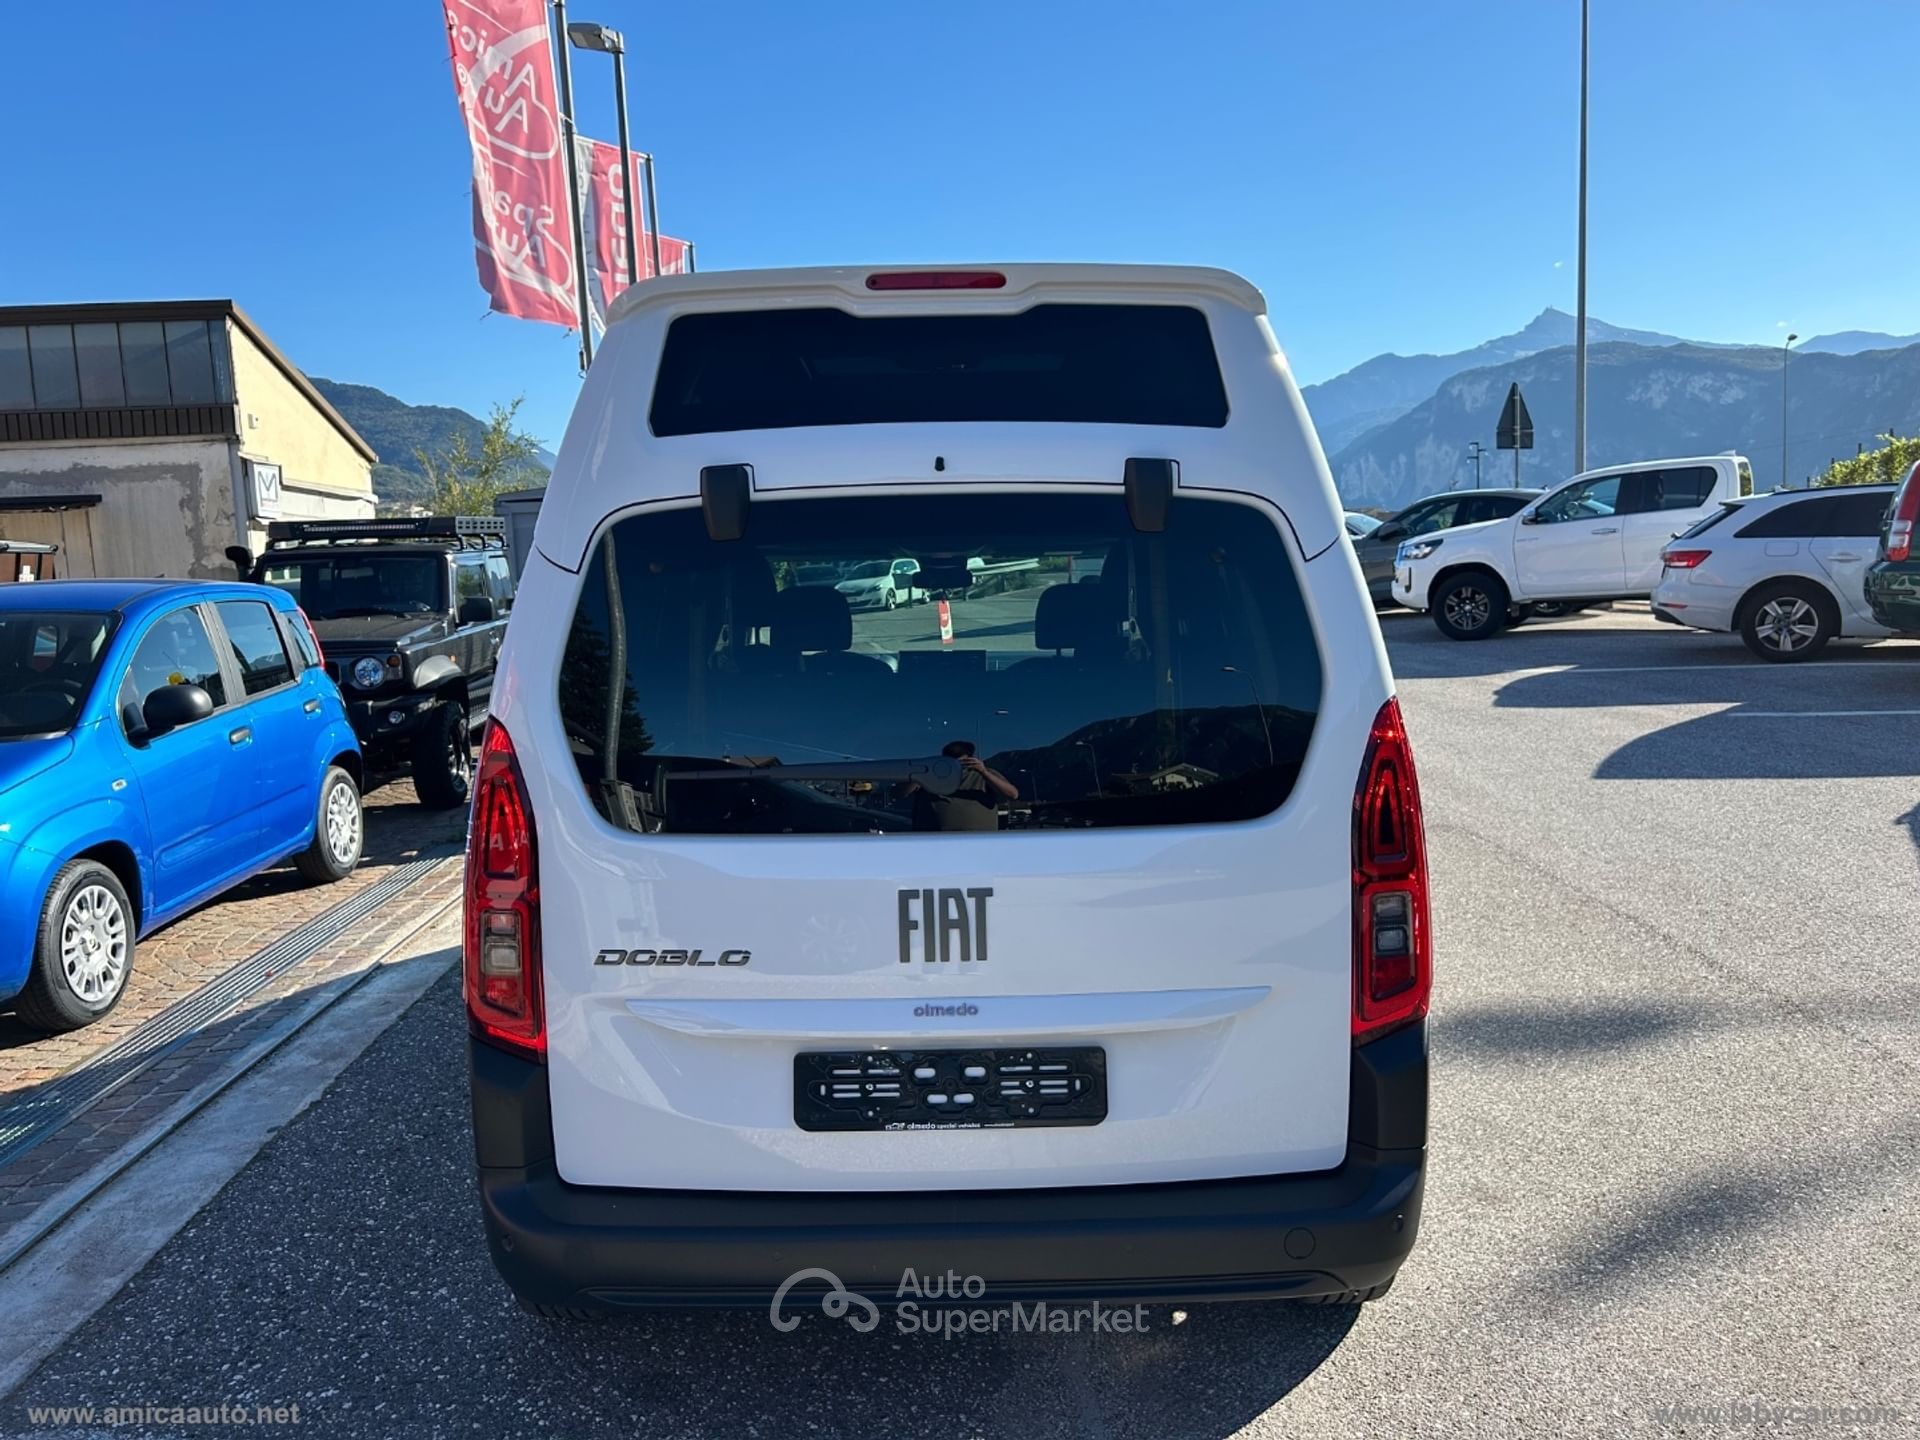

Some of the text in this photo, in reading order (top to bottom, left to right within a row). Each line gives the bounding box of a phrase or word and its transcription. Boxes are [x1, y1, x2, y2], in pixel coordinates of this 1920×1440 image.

[897, 887, 994, 963] FIAT
[594, 949, 752, 967] DOBLO
[913, 1002, 980, 1018] olmedo
